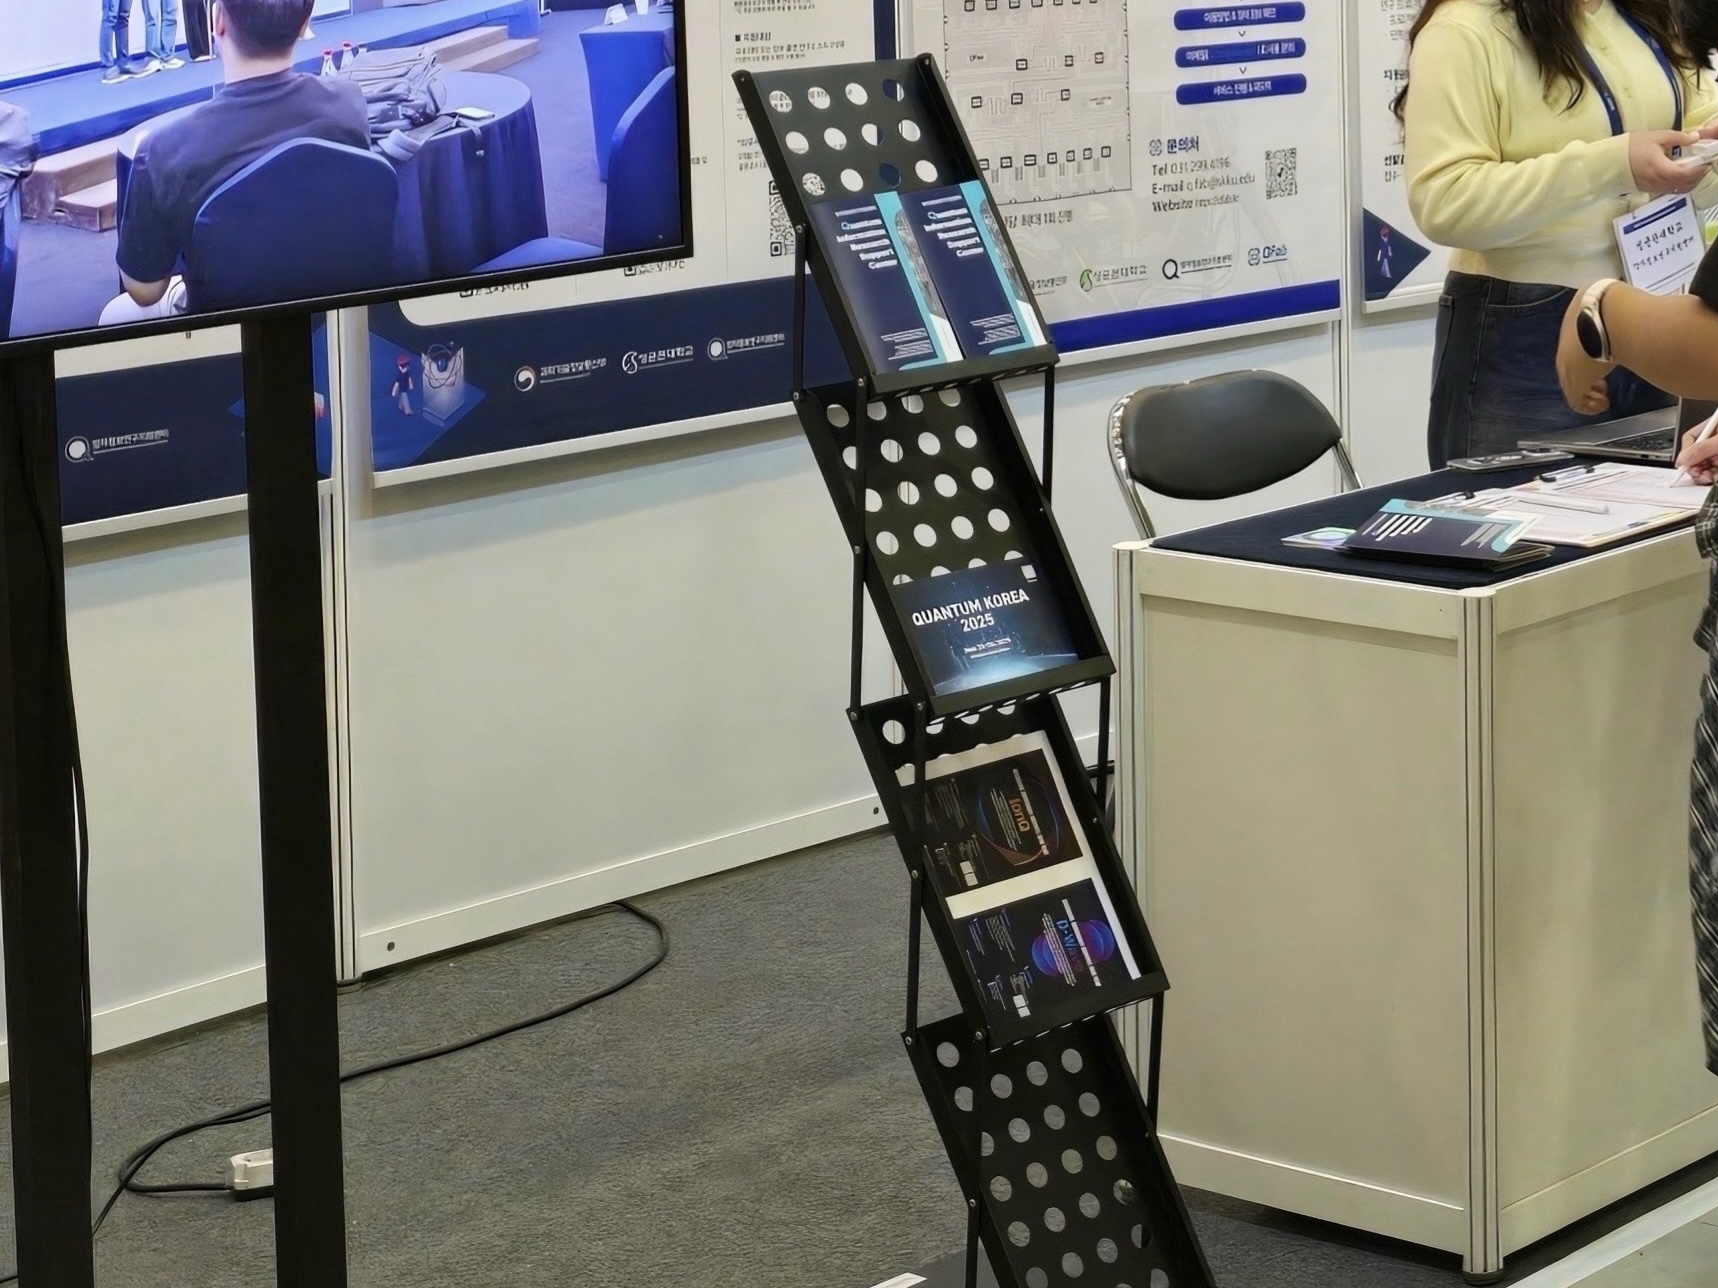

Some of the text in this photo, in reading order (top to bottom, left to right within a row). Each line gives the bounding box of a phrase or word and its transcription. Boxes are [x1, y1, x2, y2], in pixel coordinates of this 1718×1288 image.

[911, 588, 1030, 626] QUANTUM KOREA
[960, 613, 995, 632] 2025
